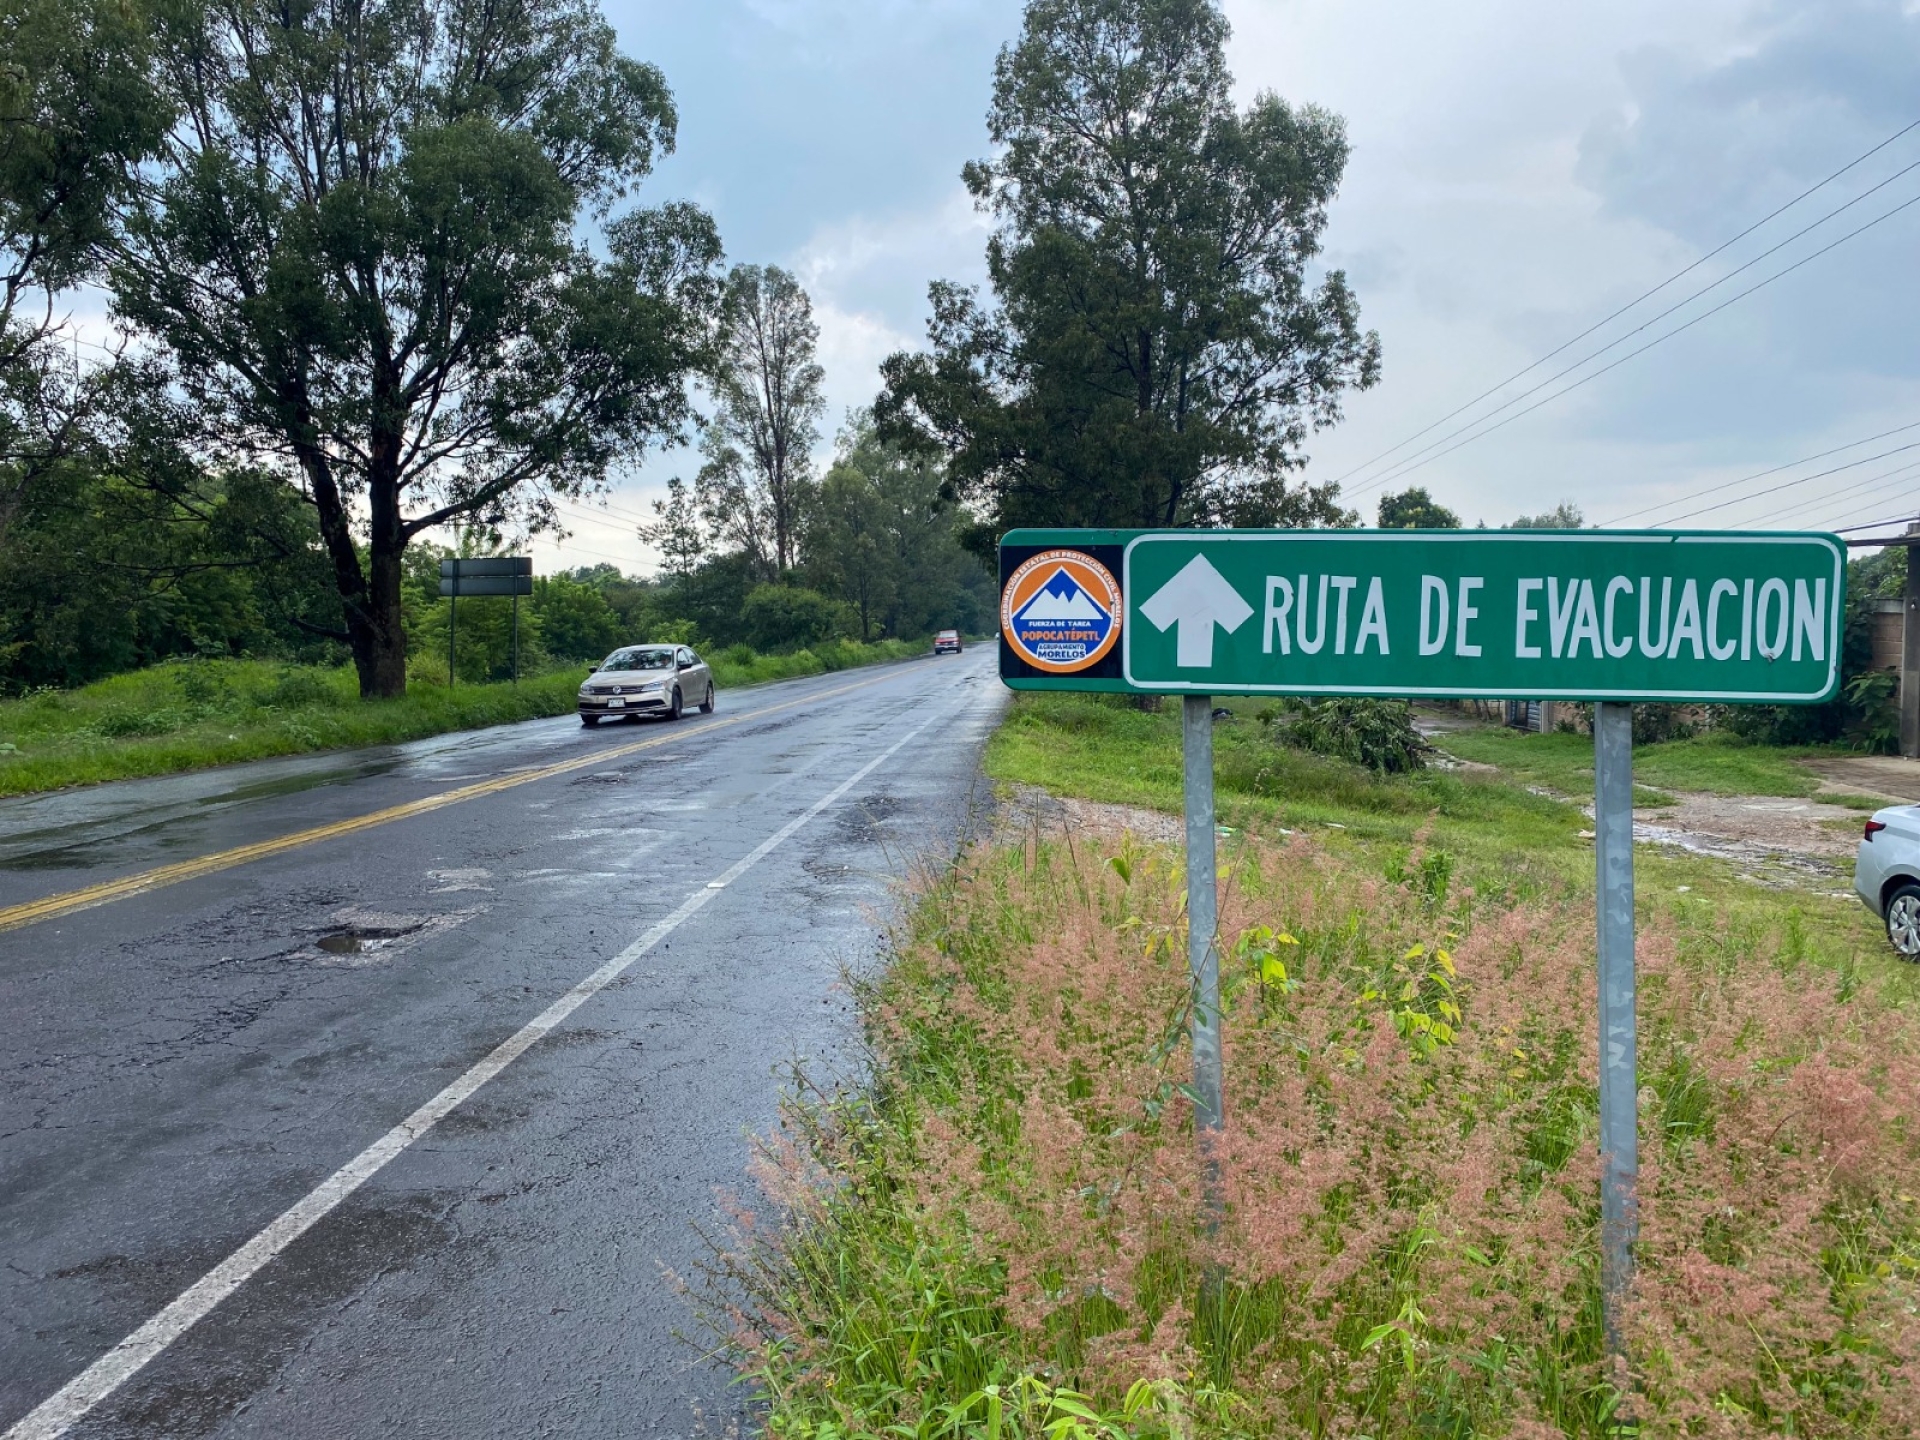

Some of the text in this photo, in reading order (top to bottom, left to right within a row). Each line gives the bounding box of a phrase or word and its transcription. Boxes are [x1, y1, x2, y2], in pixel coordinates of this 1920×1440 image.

[1019, 553, 1050, 575] ESTATAL
[1103, 574, 1117, 591] CIVIL
[1262, 574, 1826, 662] RUTA DE EVACUACION
[1021, 627, 1101, 641] POPOCATÉPETL
[1038, 650, 1086, 658] MORELOS
